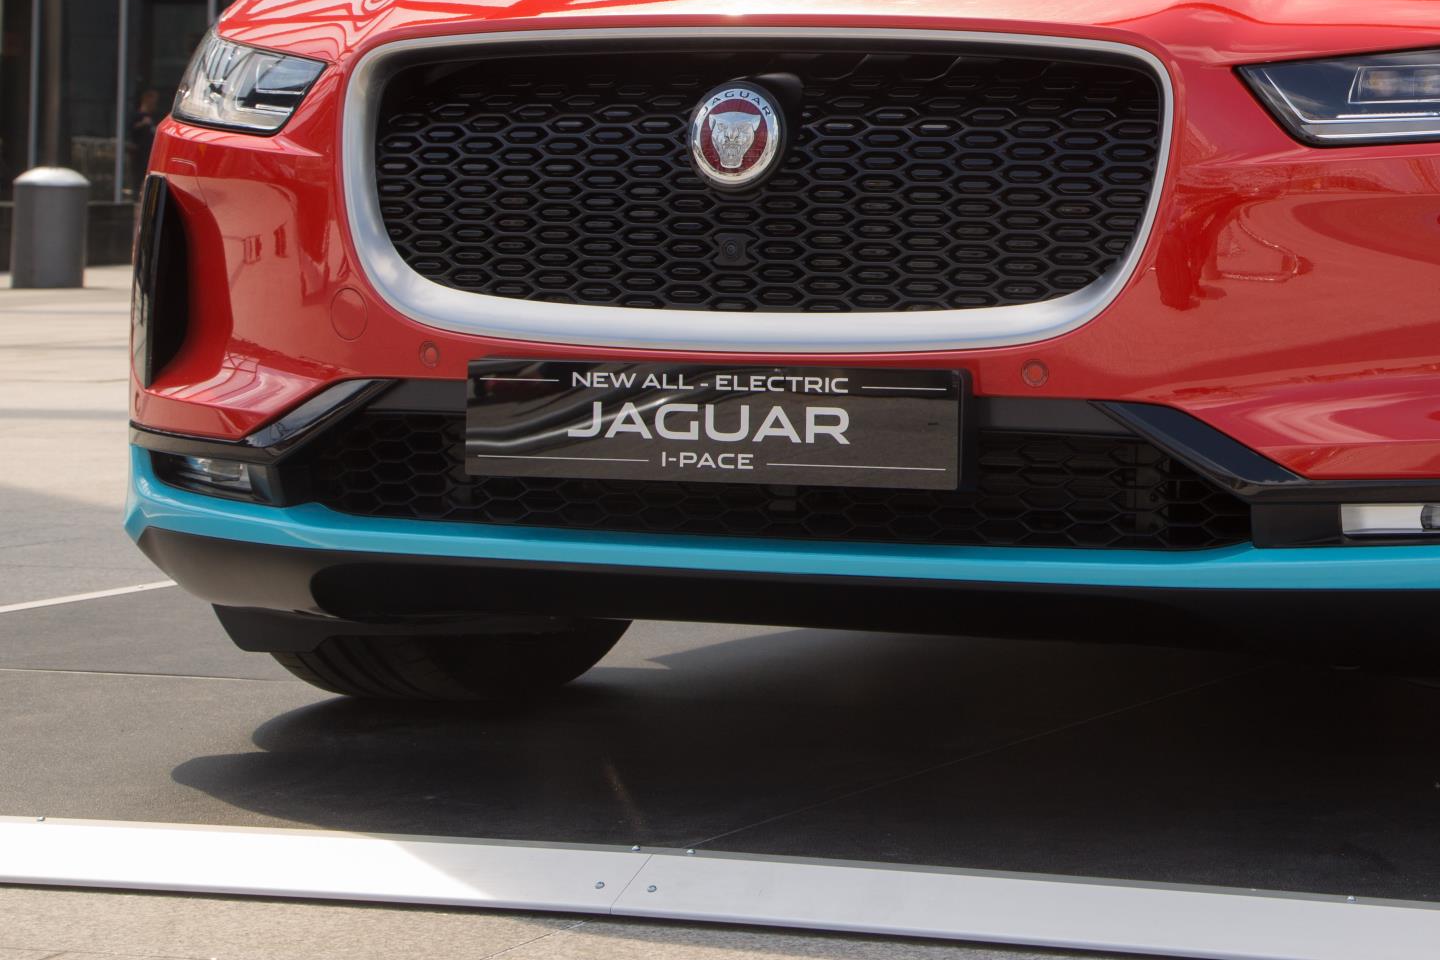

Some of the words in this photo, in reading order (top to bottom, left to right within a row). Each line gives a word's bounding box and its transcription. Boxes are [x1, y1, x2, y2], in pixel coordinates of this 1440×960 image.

[702, 90, 772, 117] JAGUAR
[571, 371, 638, 388] NEW
[641, 374, 695, 391] ALL
[714, 374, 849, 394] ELECTRIC
[566, 401, 851, 445] JAGUAR
[660, 451, 754, 470] I-PACE
